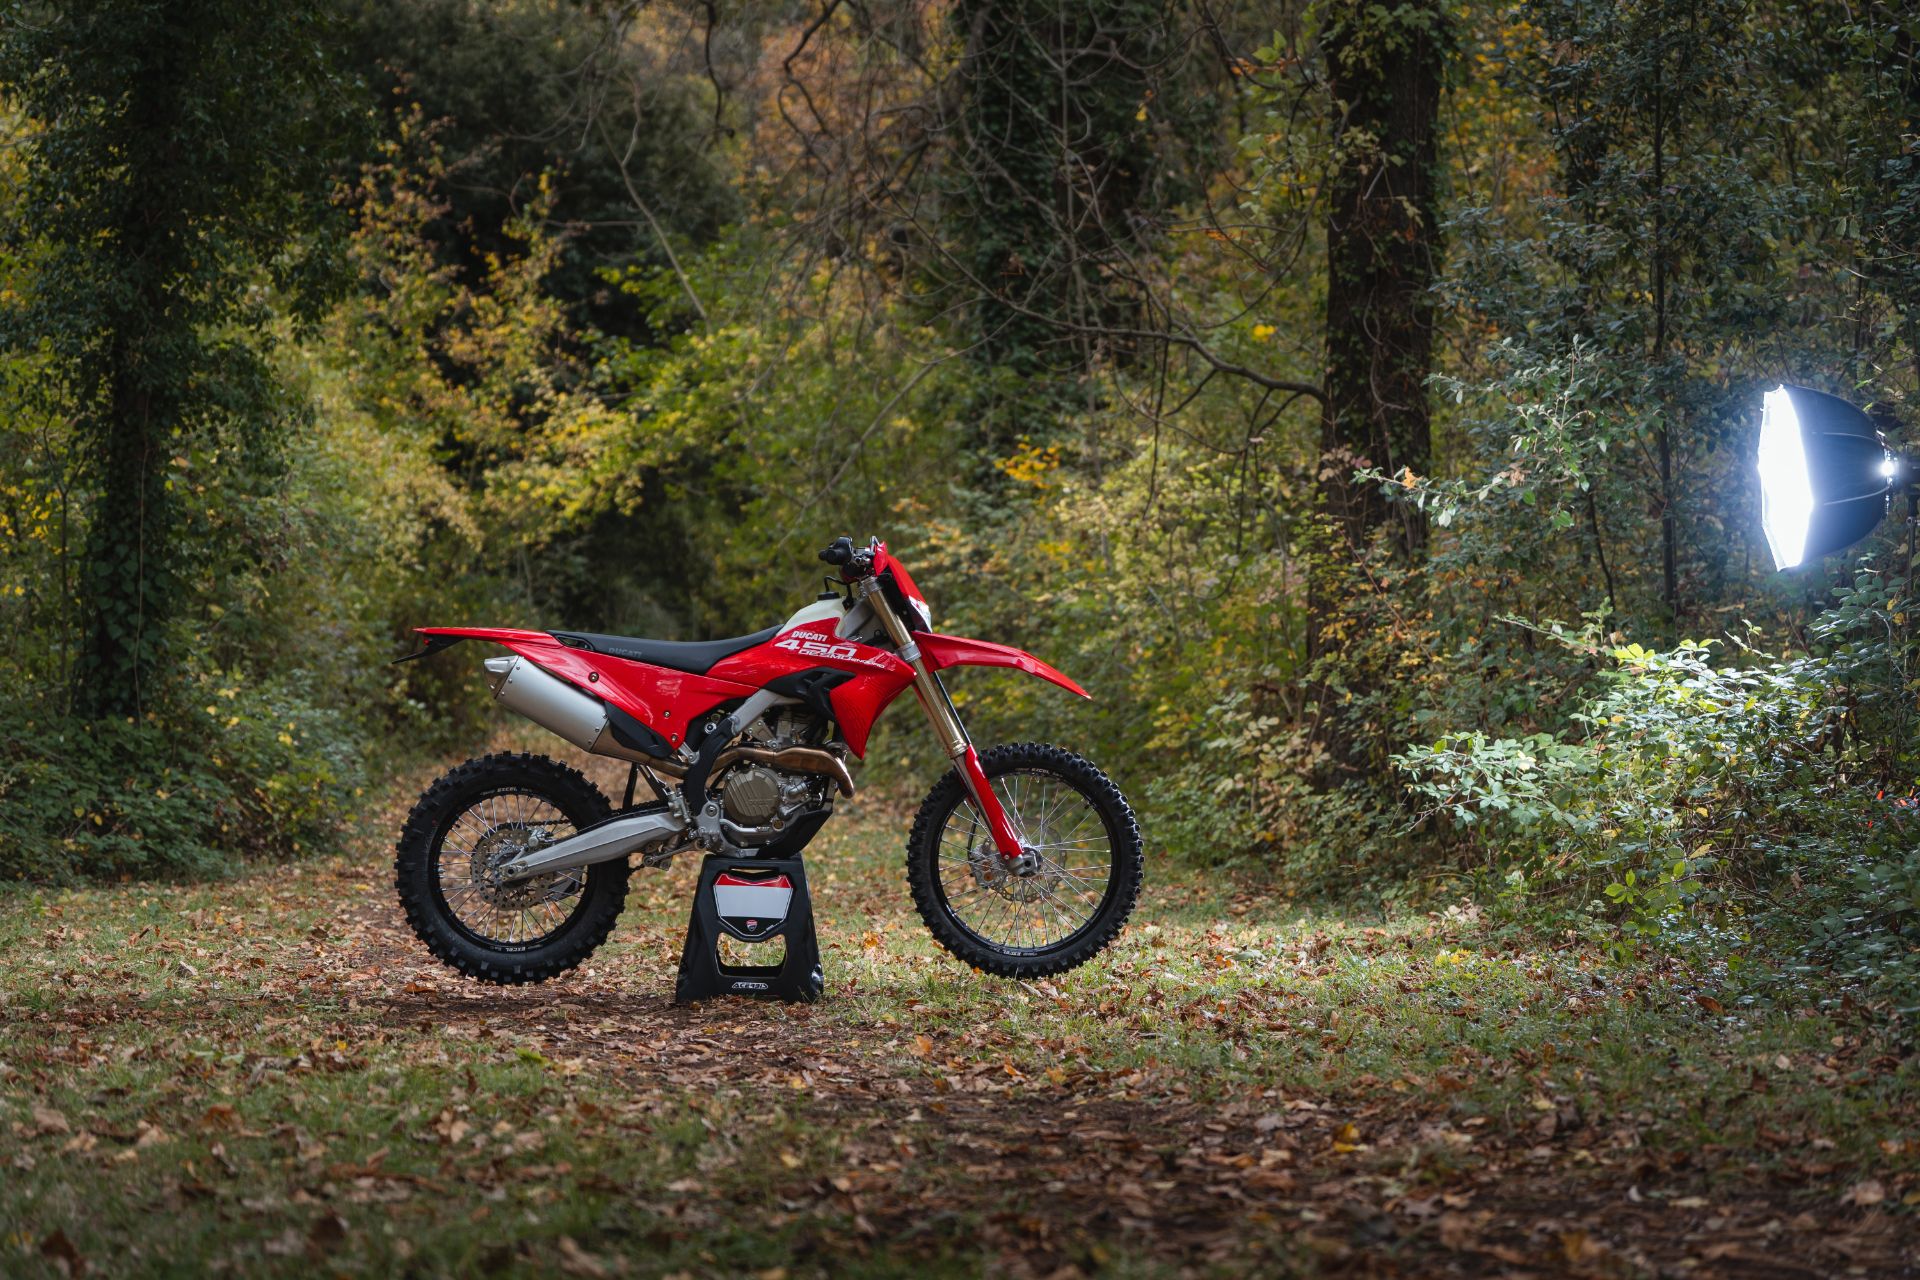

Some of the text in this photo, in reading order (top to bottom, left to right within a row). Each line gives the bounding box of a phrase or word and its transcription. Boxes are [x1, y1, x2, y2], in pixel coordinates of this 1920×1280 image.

[791, 630, 828, 641] DUCATI
[608, 647, 642, 657] DUCATI
[774, 639, 857, 657] 450
